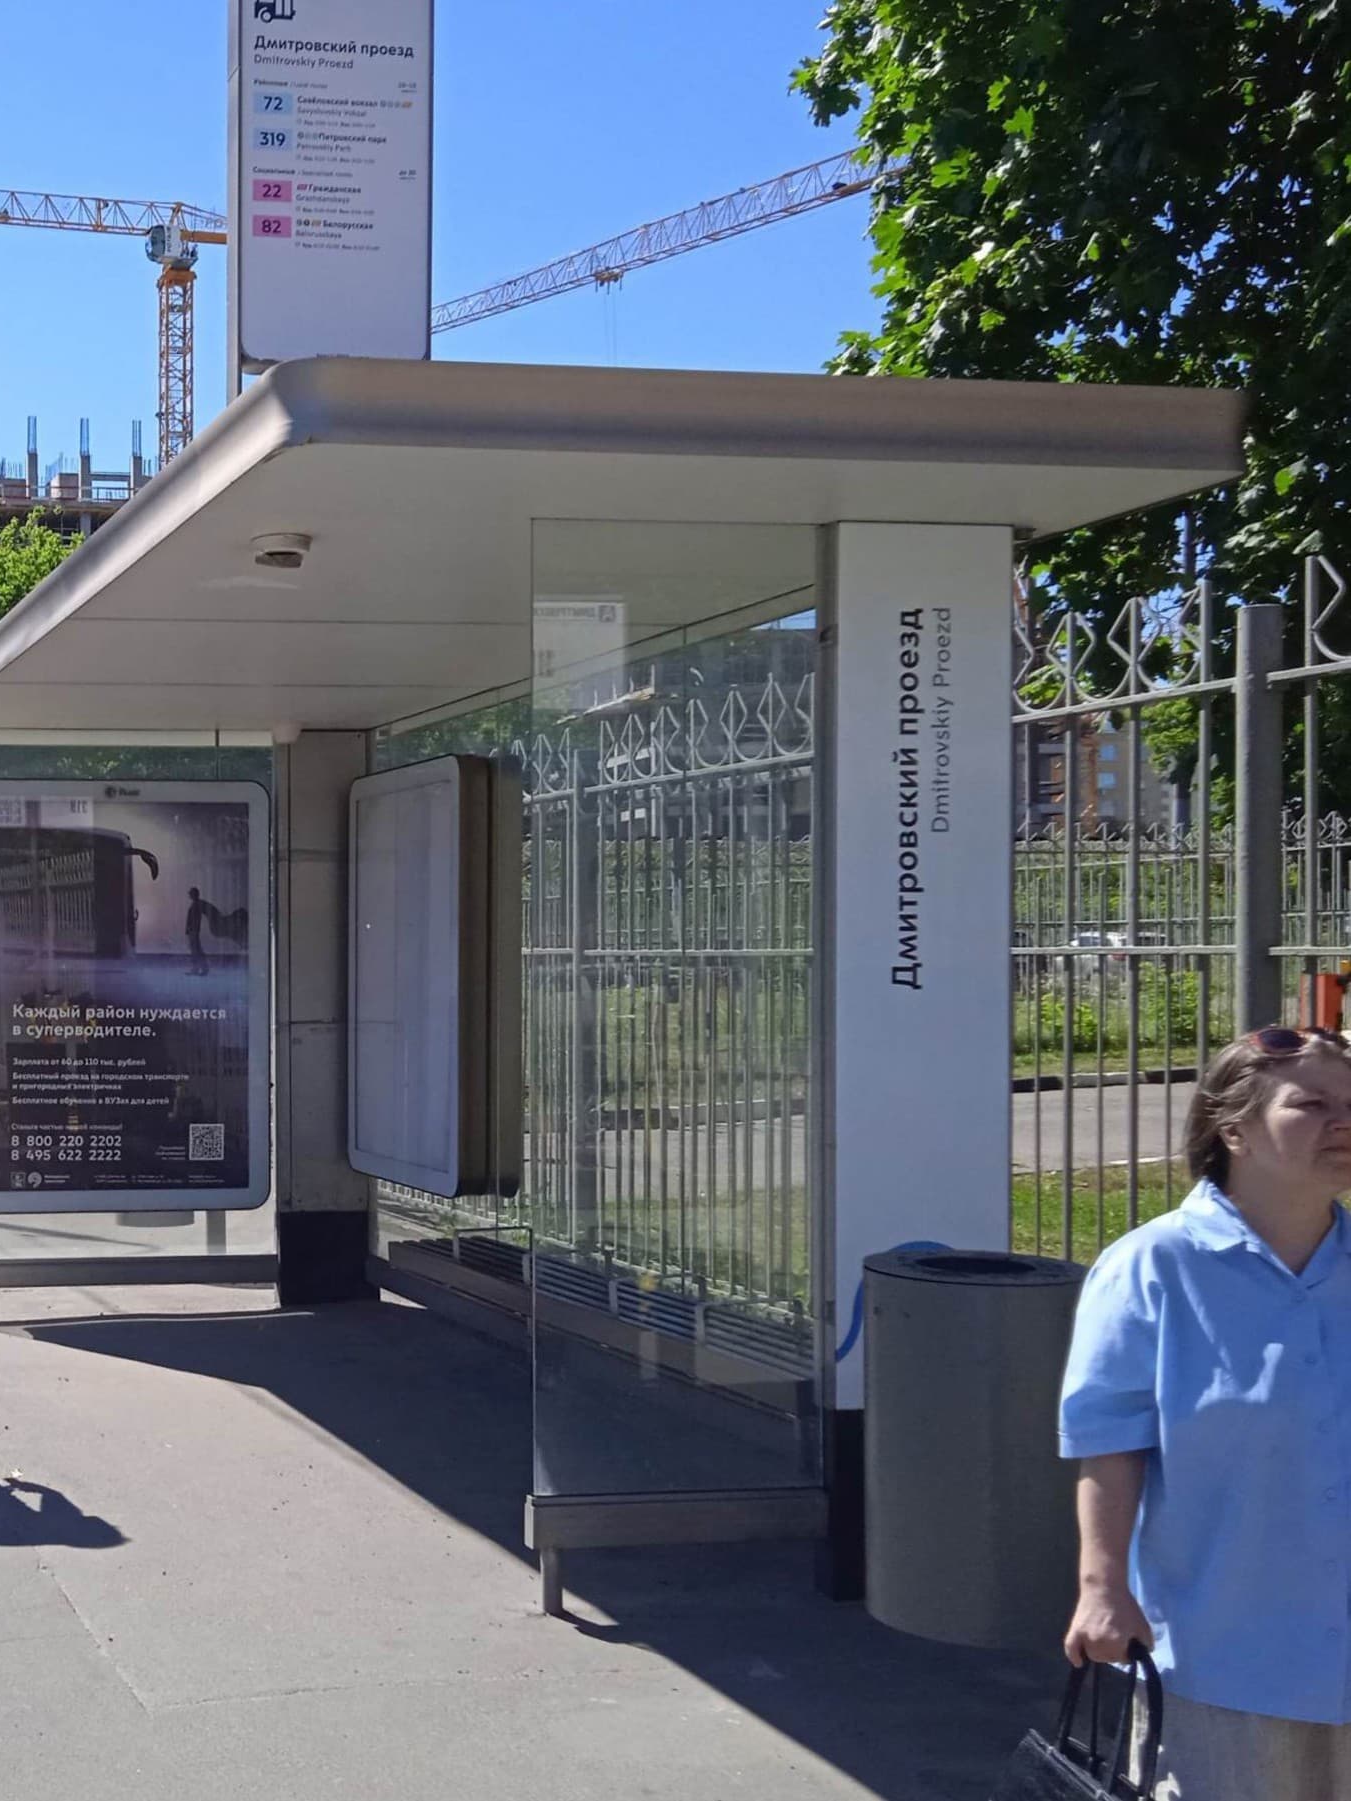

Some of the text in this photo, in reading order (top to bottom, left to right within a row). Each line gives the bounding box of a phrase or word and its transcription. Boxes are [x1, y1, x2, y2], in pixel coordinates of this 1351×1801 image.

[253, 35, 415, 58] Дмитровский проезд
[253, 54, 354, 70] Dmitrovskiy Proezd
[263, 96, 283, 111] 72
[260, 131, 286, 147] 319
[262, 183, 282, 198] 22
[262, 219, 282, 234] 82
[930, 607, 954, 833] Dmitrovskiy Proezd
[891, 607, 926, 990] Дмитровский проезд
[12, 1004, 227, 1022] Каждый район нуждается
[12, 1025, 157, 1039] в суперводителе.
[10, 1135, 122, 1147] 8 800 220 2202
[10, 1149, 122, 1161] 8 495 622 2222
